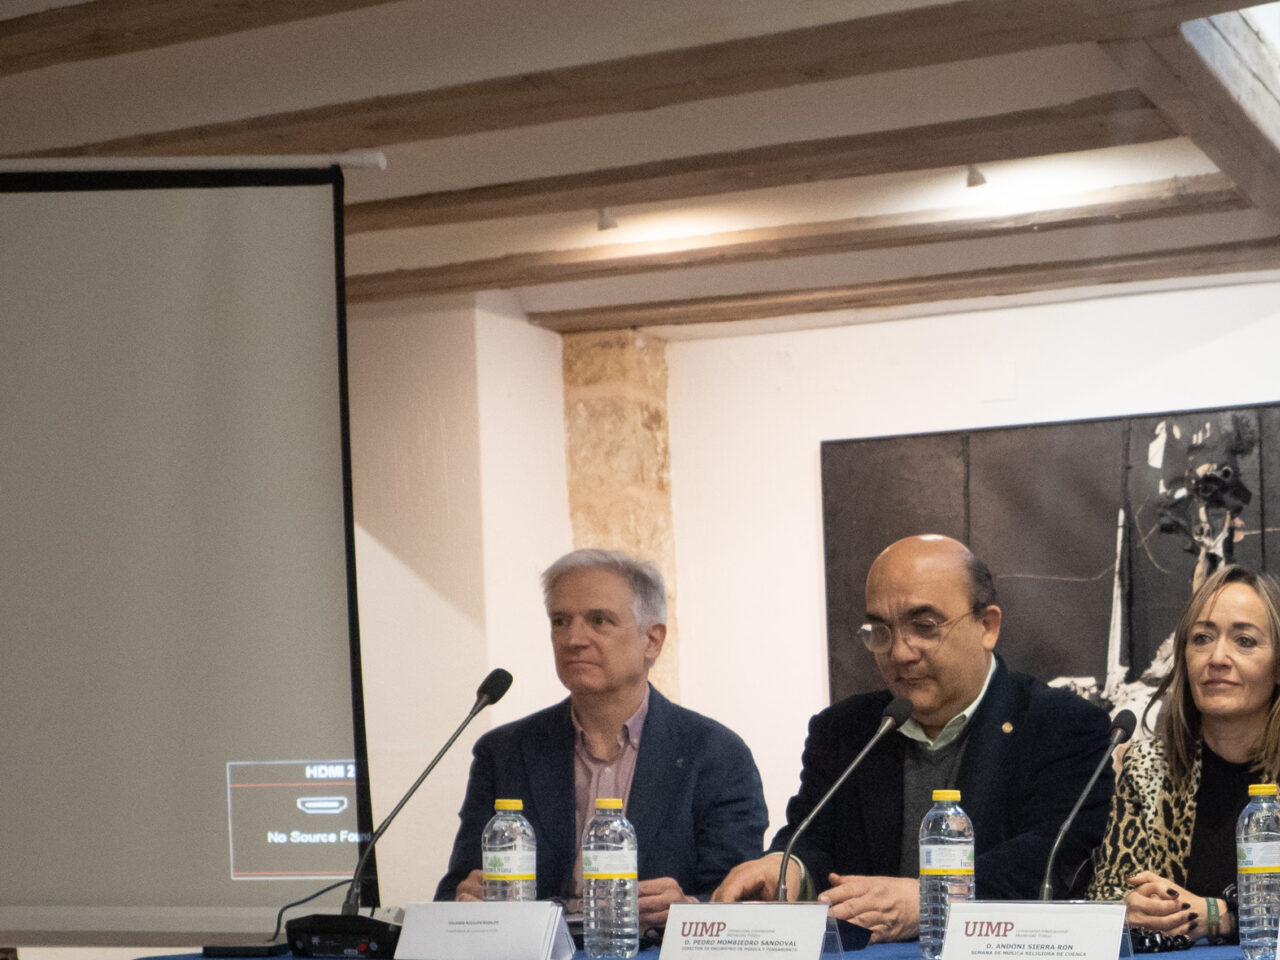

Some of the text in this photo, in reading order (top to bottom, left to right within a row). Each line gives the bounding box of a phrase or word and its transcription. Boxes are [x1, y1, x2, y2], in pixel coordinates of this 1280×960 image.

[305, 764, 357, 778] HDMI 2
[267, 831, 287, 843] No
[290, 830, 337, 843] Source
[681, 921, 727, 937] UIMP
[964, 921, 1015, 937] UIMP
[760, 939, 797, 947] SANDOVAL
